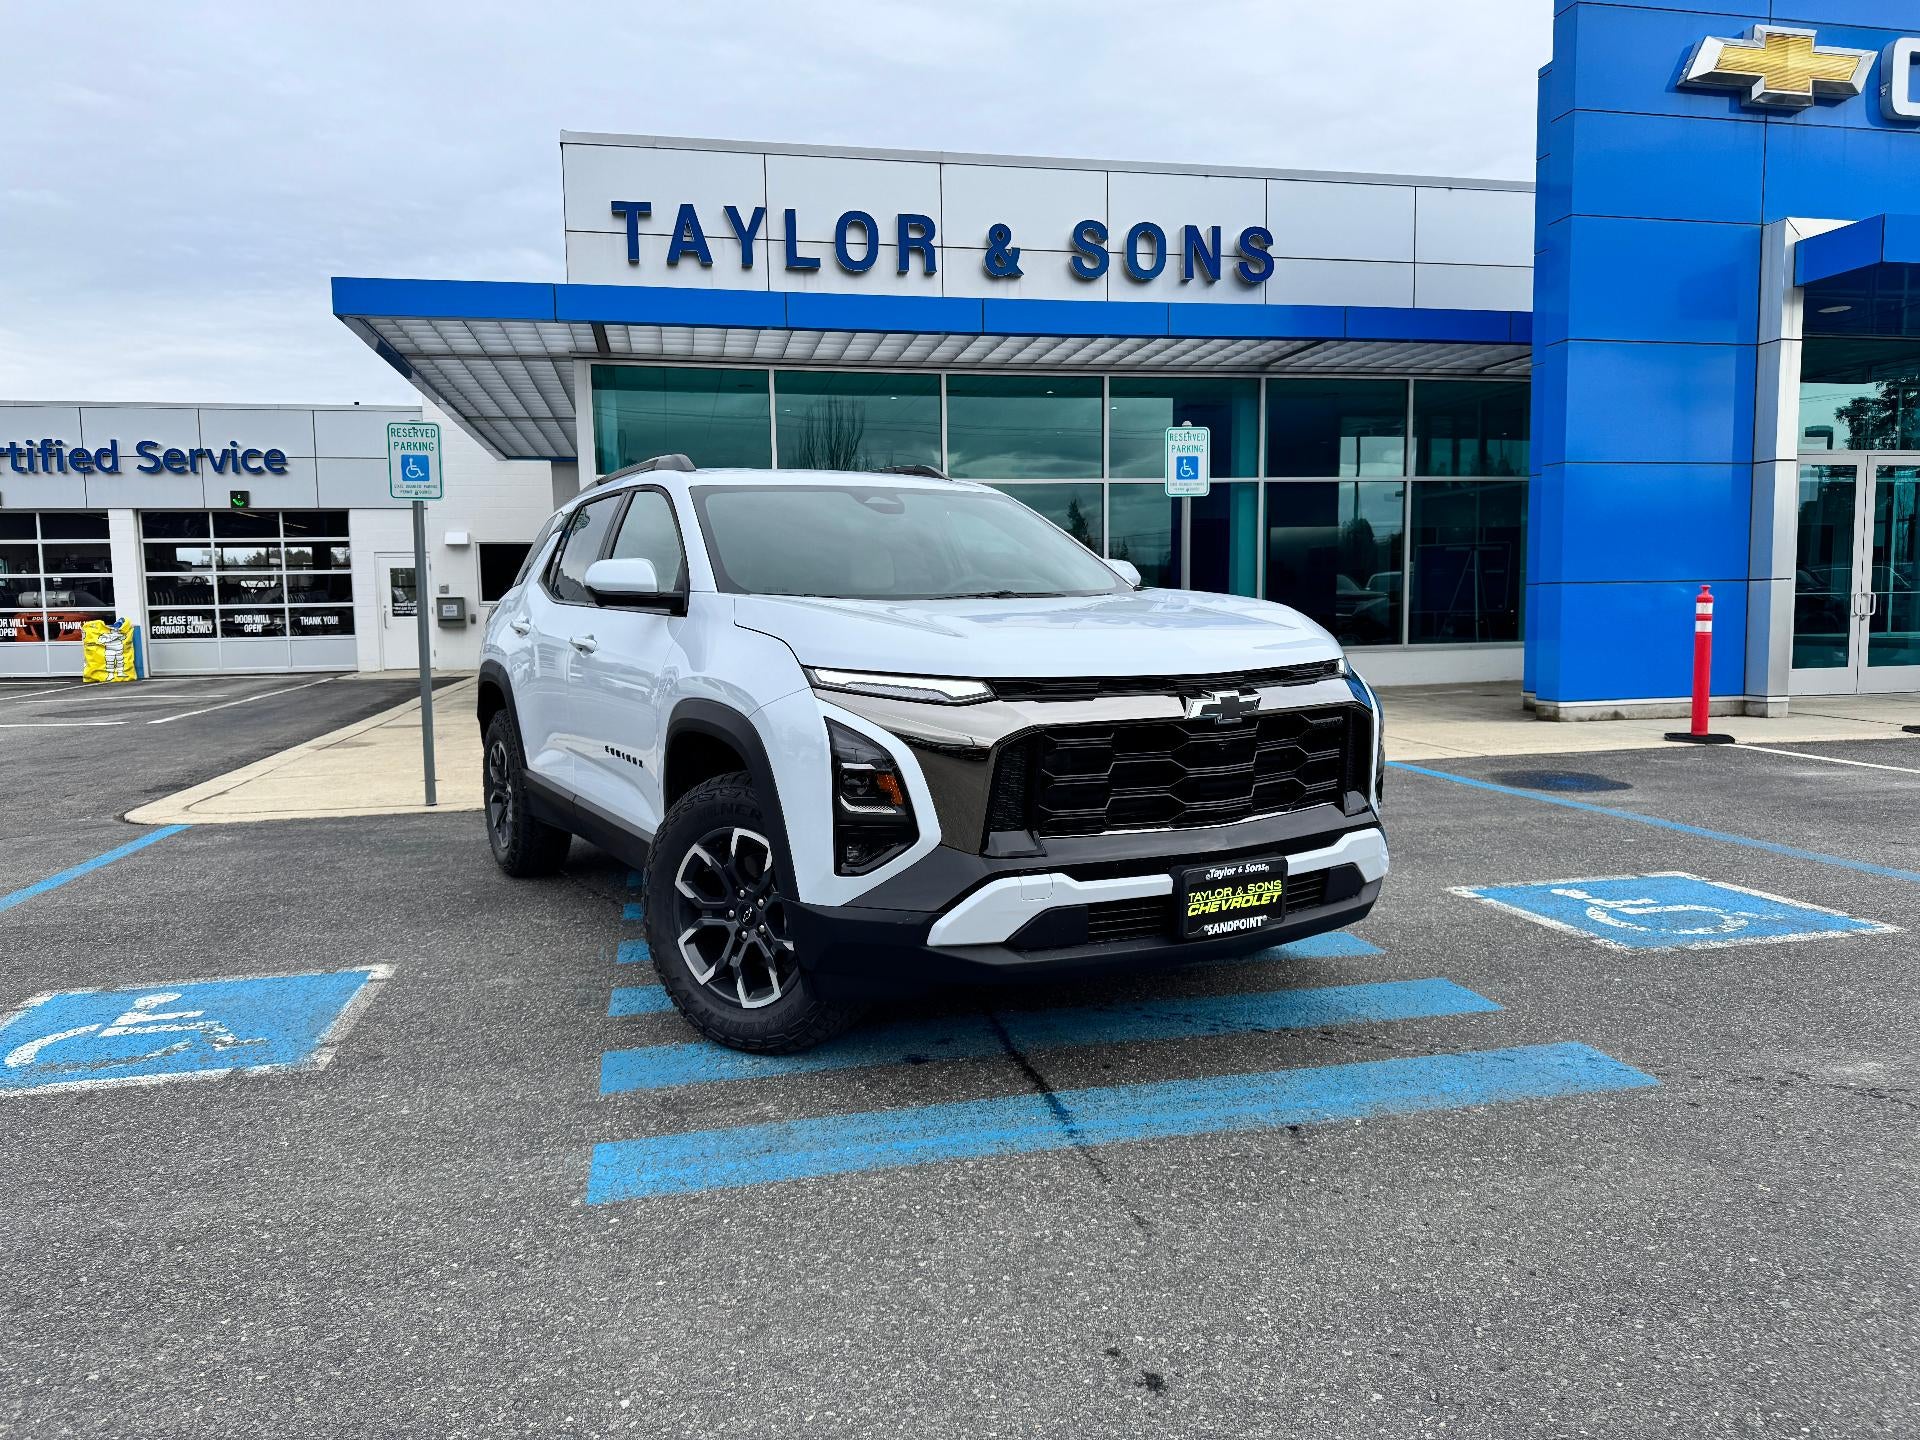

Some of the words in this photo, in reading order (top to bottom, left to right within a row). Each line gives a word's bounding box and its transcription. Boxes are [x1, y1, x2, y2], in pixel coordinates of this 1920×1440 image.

[611, 200, 938, 276] TAYLOR
[984, 223, 1023, 279] &
[1071, 219, 1275, 284] SONS
[391, 427, 436, 438] RESERVED
[1169, 432, 1206, 442] RESERVED
[394, 441, 435, 452] PARKING
[1171, 444, 1204, 454] PARKING
[135, 440, 288, 475] Service
[9, 618, 27, 628] WILL
[160, 616, 186, 625] PLEASE
[187, 615, 204, 625] PULL
[234, 615, 254, 624] DOOR
[255, 614, 271, 624] WILL
[300, 616, 322, 625] THANK
[323, 616, 339, 625] YOU!
[152, 625, 185, 634] FORWARD
[187, 624, 213, 634] SLOWLY
[244, 624, 263, 633] OPEN
[1209, 867, 1237, 880] Taylor
[1245, 863, 1266, 873] Sons
[1188, 886, 1233, 903] TAYLOR
[1235, 886, 1244, 896] &
[1247, 880, 1282, 894] SONS
[1187, 891, 1283, 917] CHEVROLET
[1207, 916, 1264, 936] SANDPOINT
